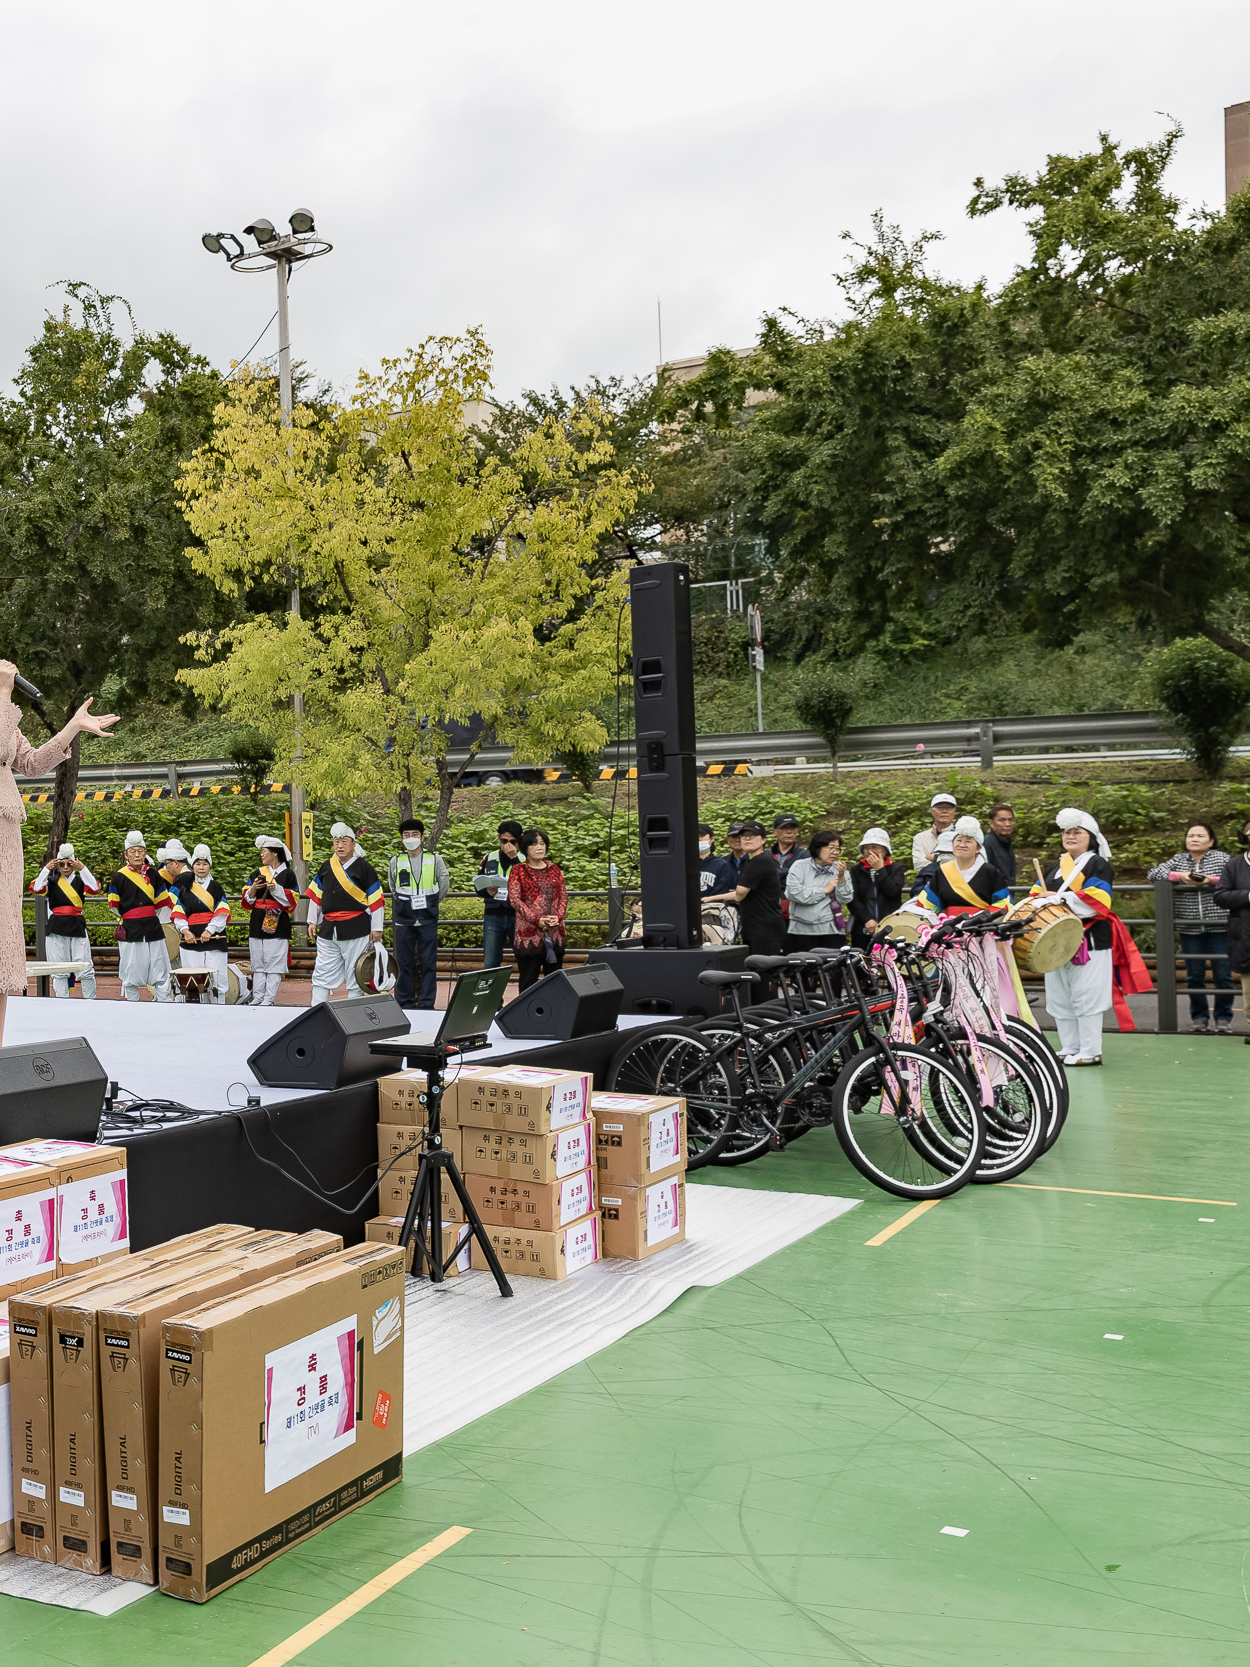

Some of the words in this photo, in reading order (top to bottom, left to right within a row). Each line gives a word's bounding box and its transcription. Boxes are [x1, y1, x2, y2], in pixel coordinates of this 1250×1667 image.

[88, 1189, 96, 1202] 축
[14, 1209, 23, 1222] 축
[307, 1352, 318, 1373] 축
[285, 1408, 306, 1430] 제11회
[327, 1391, 340, 1407] 축제
[25, 1418, 34, 1463] DIGITAL
[307, 1422, 319, 1440] (TV)
[69, 1431, 77, 1476] DIGITAL
[119, 1434, 129, 1480] DIGITAL
[174, 1450, 183, 1496] DIGITAL
[362, 1470, 385, 1489] HDMI
[315, 1497, 336, 1516] FAST
[231, 1543, 261, 1570] 40FHD
[261, 1532, 283, 1552] Series
